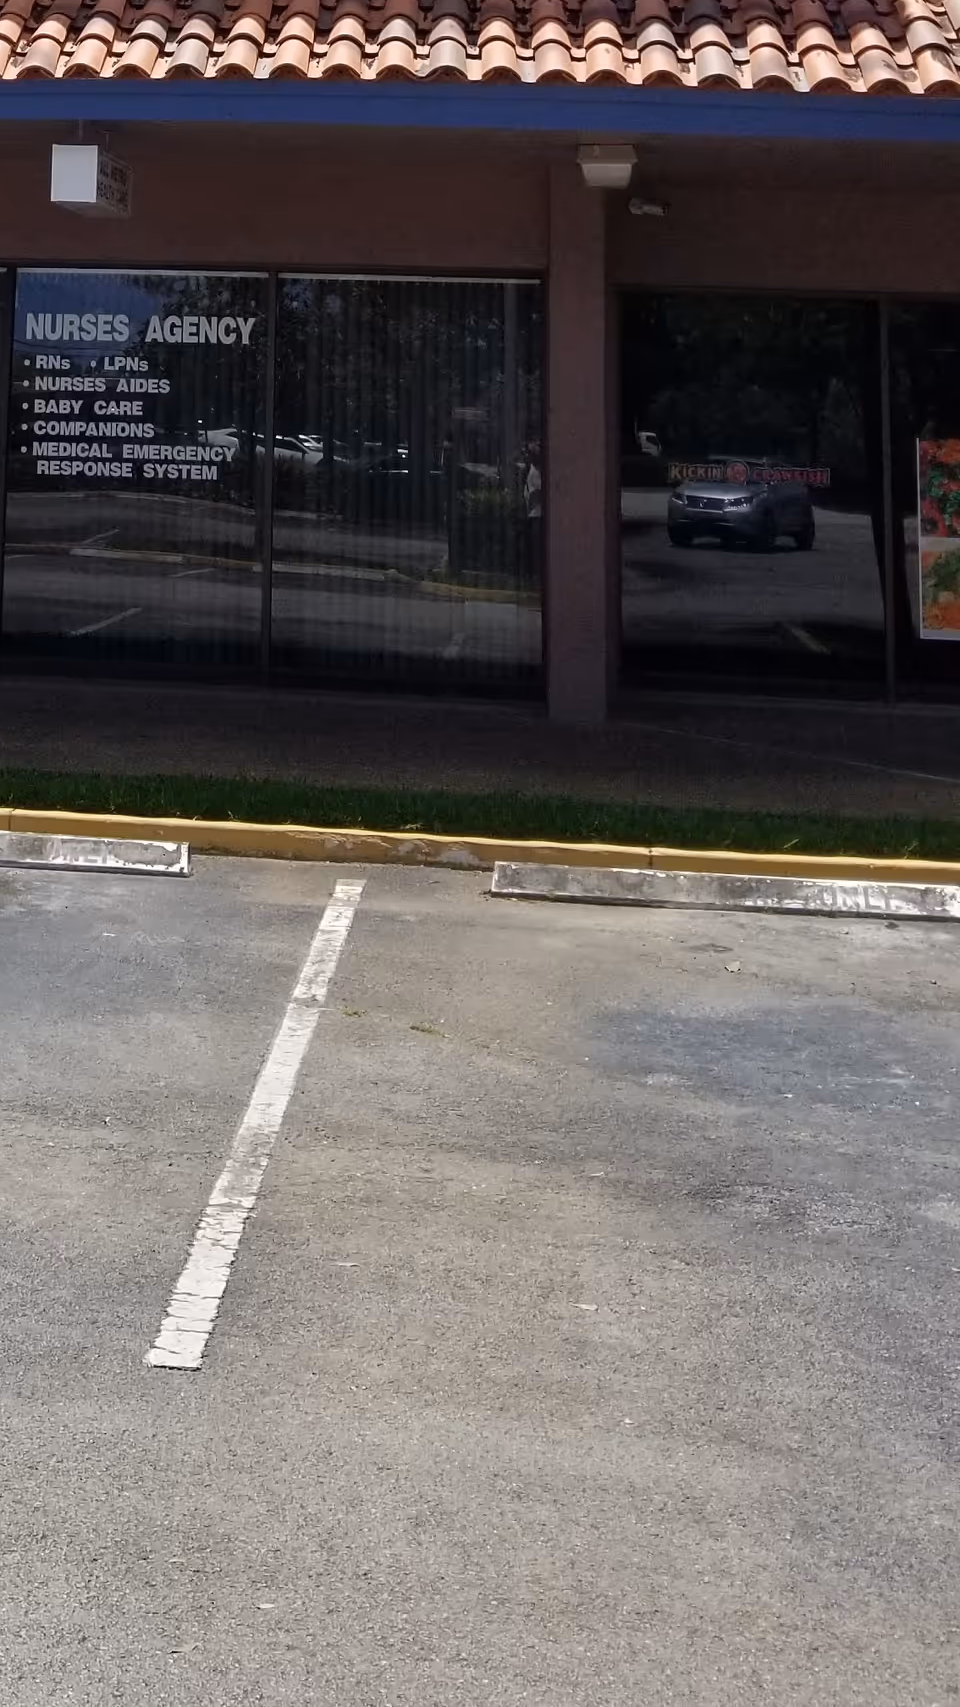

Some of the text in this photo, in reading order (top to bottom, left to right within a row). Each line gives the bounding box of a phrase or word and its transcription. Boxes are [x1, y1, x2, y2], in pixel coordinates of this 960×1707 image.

[25, 312, 256, 345] NURSES AGENCY
[35, 355, 149, 372] RNs LPNs
[34, 376, 171, 393] NURSES AIDES
[33, 399, 143, 416] BABY CARE
[33, 420, 155, 438] COMPANIONS
[32, 441, 236, 462] MEDICAL EMERGENCY
[36, 460, 218, 481] RESPONSE SYSTEM
[670, 464, 723, 481] KICKIN
